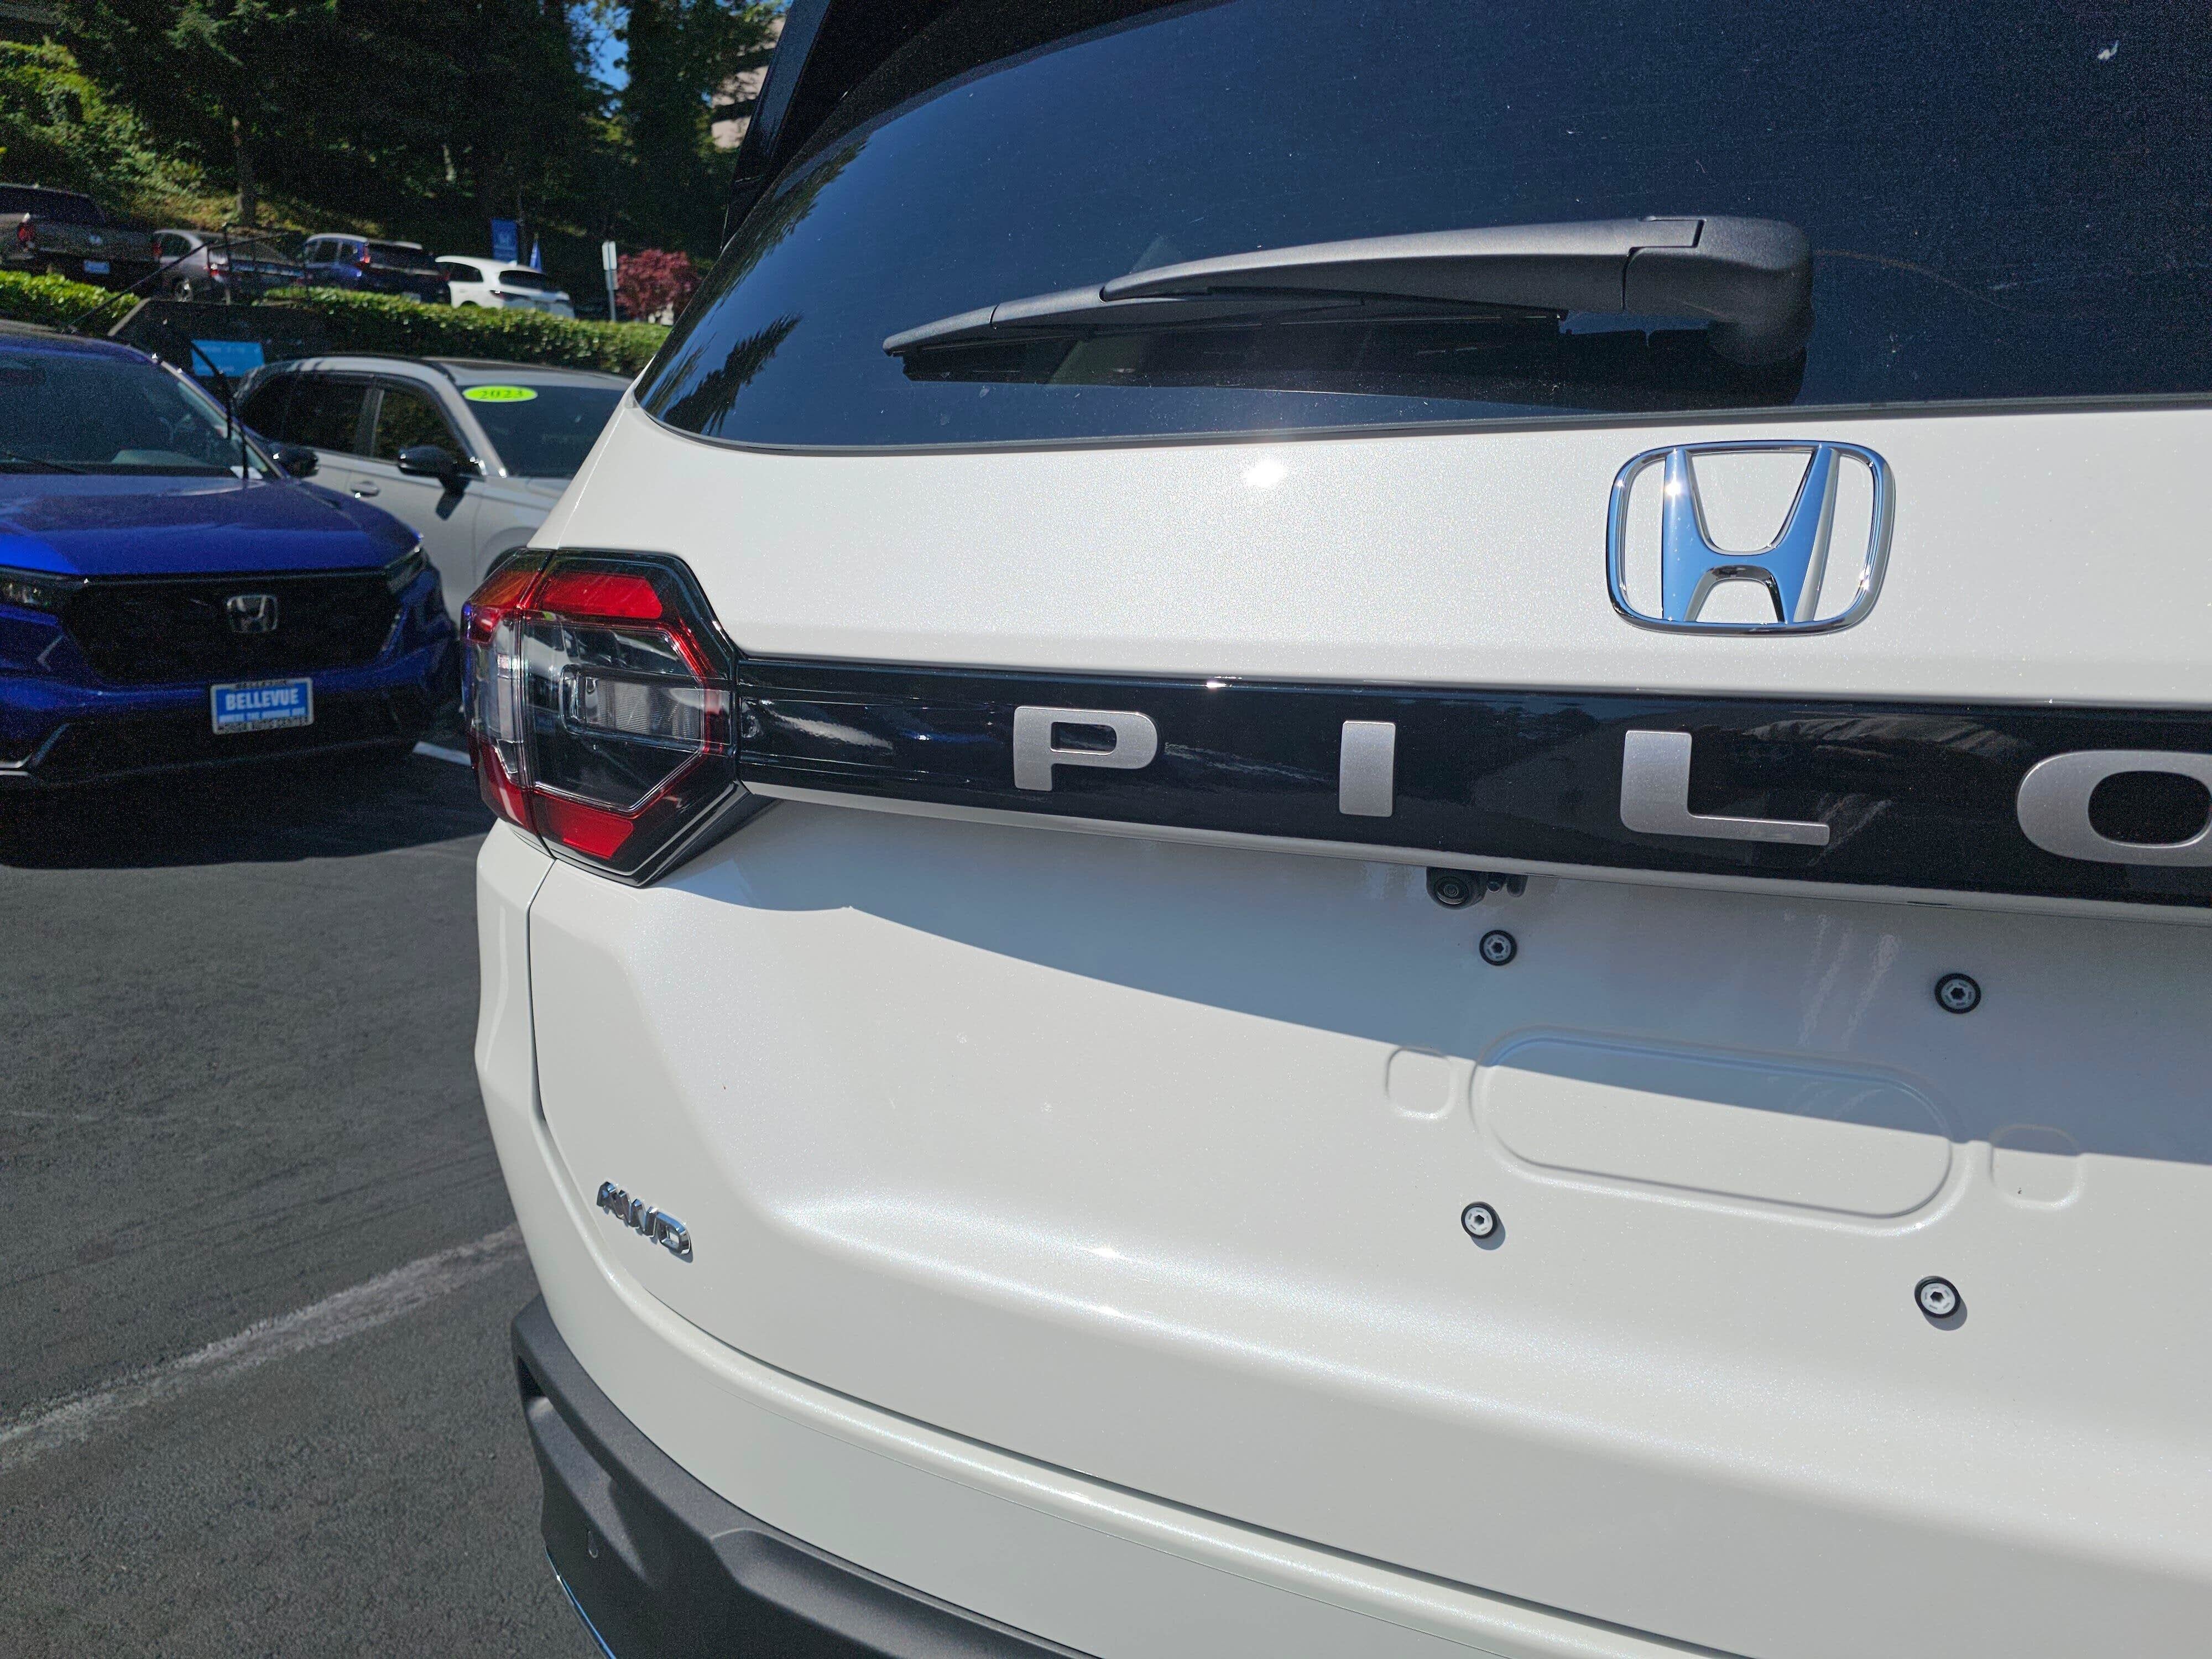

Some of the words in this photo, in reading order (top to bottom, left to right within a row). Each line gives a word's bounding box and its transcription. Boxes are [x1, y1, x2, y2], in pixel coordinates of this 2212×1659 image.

[477, 389, 524, 399] 2023
[225, 688, 299, 711] BELLEVUE
[1014, 705, 2212, 867] PILO
[596, 1181, 691, 1255] AWD
